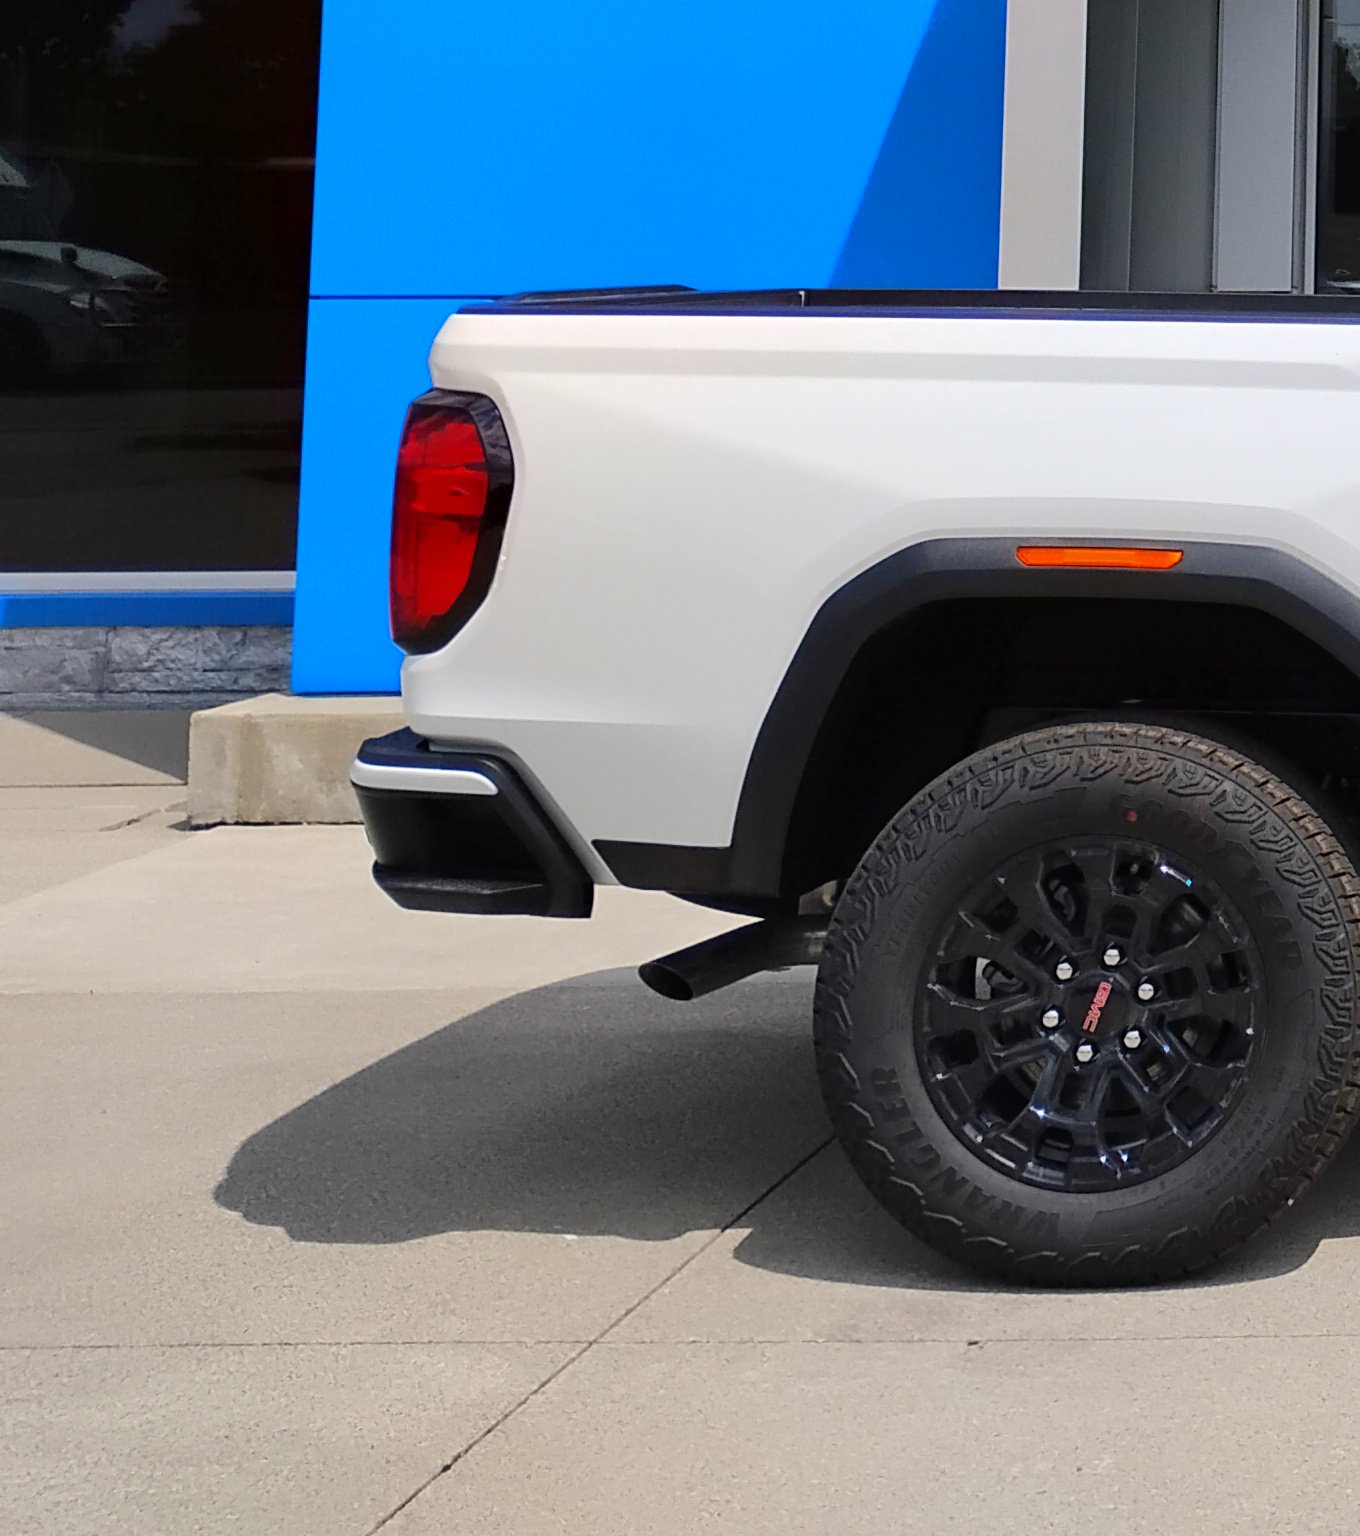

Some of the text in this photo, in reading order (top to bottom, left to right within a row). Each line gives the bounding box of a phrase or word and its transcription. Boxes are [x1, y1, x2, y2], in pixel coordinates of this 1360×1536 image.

[1110, 792, 1303, 969] GOODYEAR
[1082, 980, 1113, 1034] GMC
[872, 1065, 1061, 1240] WRANGLER
